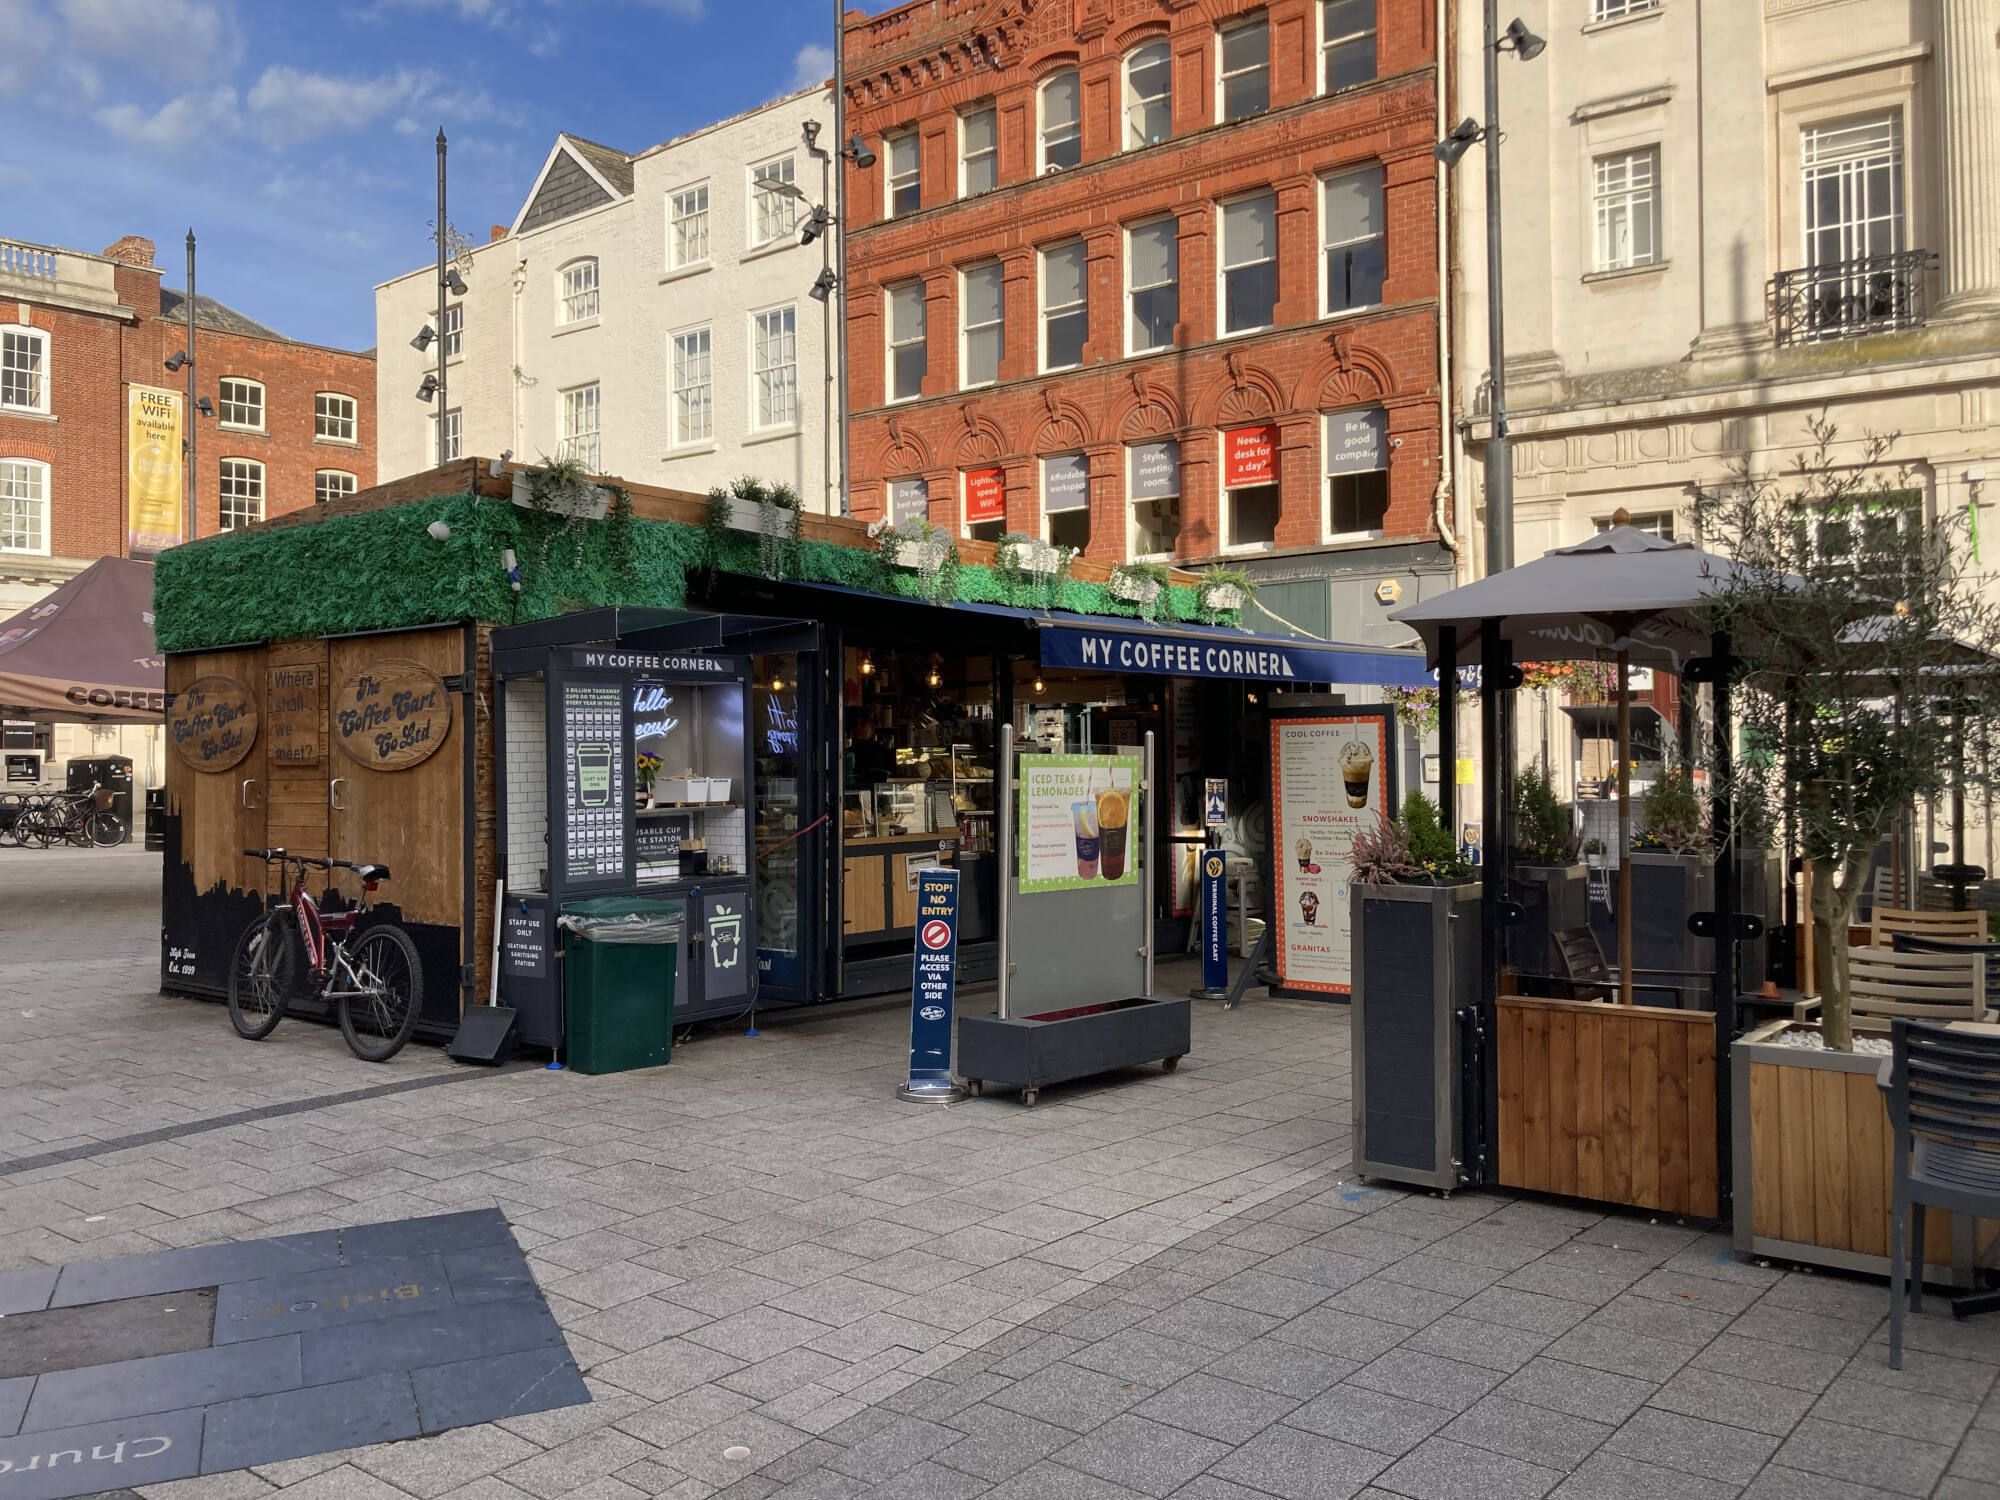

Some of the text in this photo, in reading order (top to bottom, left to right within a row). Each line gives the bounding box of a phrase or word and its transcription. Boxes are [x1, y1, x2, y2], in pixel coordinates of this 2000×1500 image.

[140, 392, 172, 407] FREE
[142, 404, 170, 419] WiFi
[137, 419, 176, 432] available
[1346, 423, 1357, 431] Be
[146, 430, 167, 440] here
[1237, 434, 1260, 446] Need
[1344, 434, 1370, 448] good
[1142, 450, 1170, 463] Stylish
[1235, 448, 1270, 460] desk for
[1139, 464, 1173, 475] meeting
[1246, 460, 1266, 472] day?
[970, 476, 1004, 487] Lightning
[1143, 478, 1169, 488] rooms
[900, 490, 909, 498] Do
[976, 487, 998, 497] speed
[897, 501, 911, 509] best
[980, 499, 995, 508] WiFi
[586, 653, 714, 671] MY COFFEE CORNER
[1081, 637, 1280, 676] MY COFFEE CORNER
[275, 671, 314, 688] Where
[356, 676, 381, 702] The
[65, 686, 165, 712] COFFE
[186, 688, 205, 711] The
[275, 694, 304, 712] shall
[338, 688, 437, 738] Coffee Cart
[174, 701, 248, 743] Coffee Cart
[275, 723, 292, 737] we
[375, 718, 431, 758] Co Ltd
[201, 736, 218, 761] Co
[275, 744, 313, 761] meet?
[1032, 774, 1084, 785] ICED TEAS &
[1031, 786, 1085, 797] LEMONADES
[650, 835, 681, 844] STATION
[924, 883, 953, 892] STOP!
[930, 895, 946, 904] NO
[922, 906, 954, 916] ENTRY
[1291, 944, 1330, 952] GRANITAS
[511, 951, 539, 959] SANITISING
[921, 954, 950, 962] PLEASE
[920, 963, 950, 971] ACCESS
[928, 973, 941, 981] VIA
[921, 982, 947, 990] OTHER
[925, 991, 943, 999] SIDE
